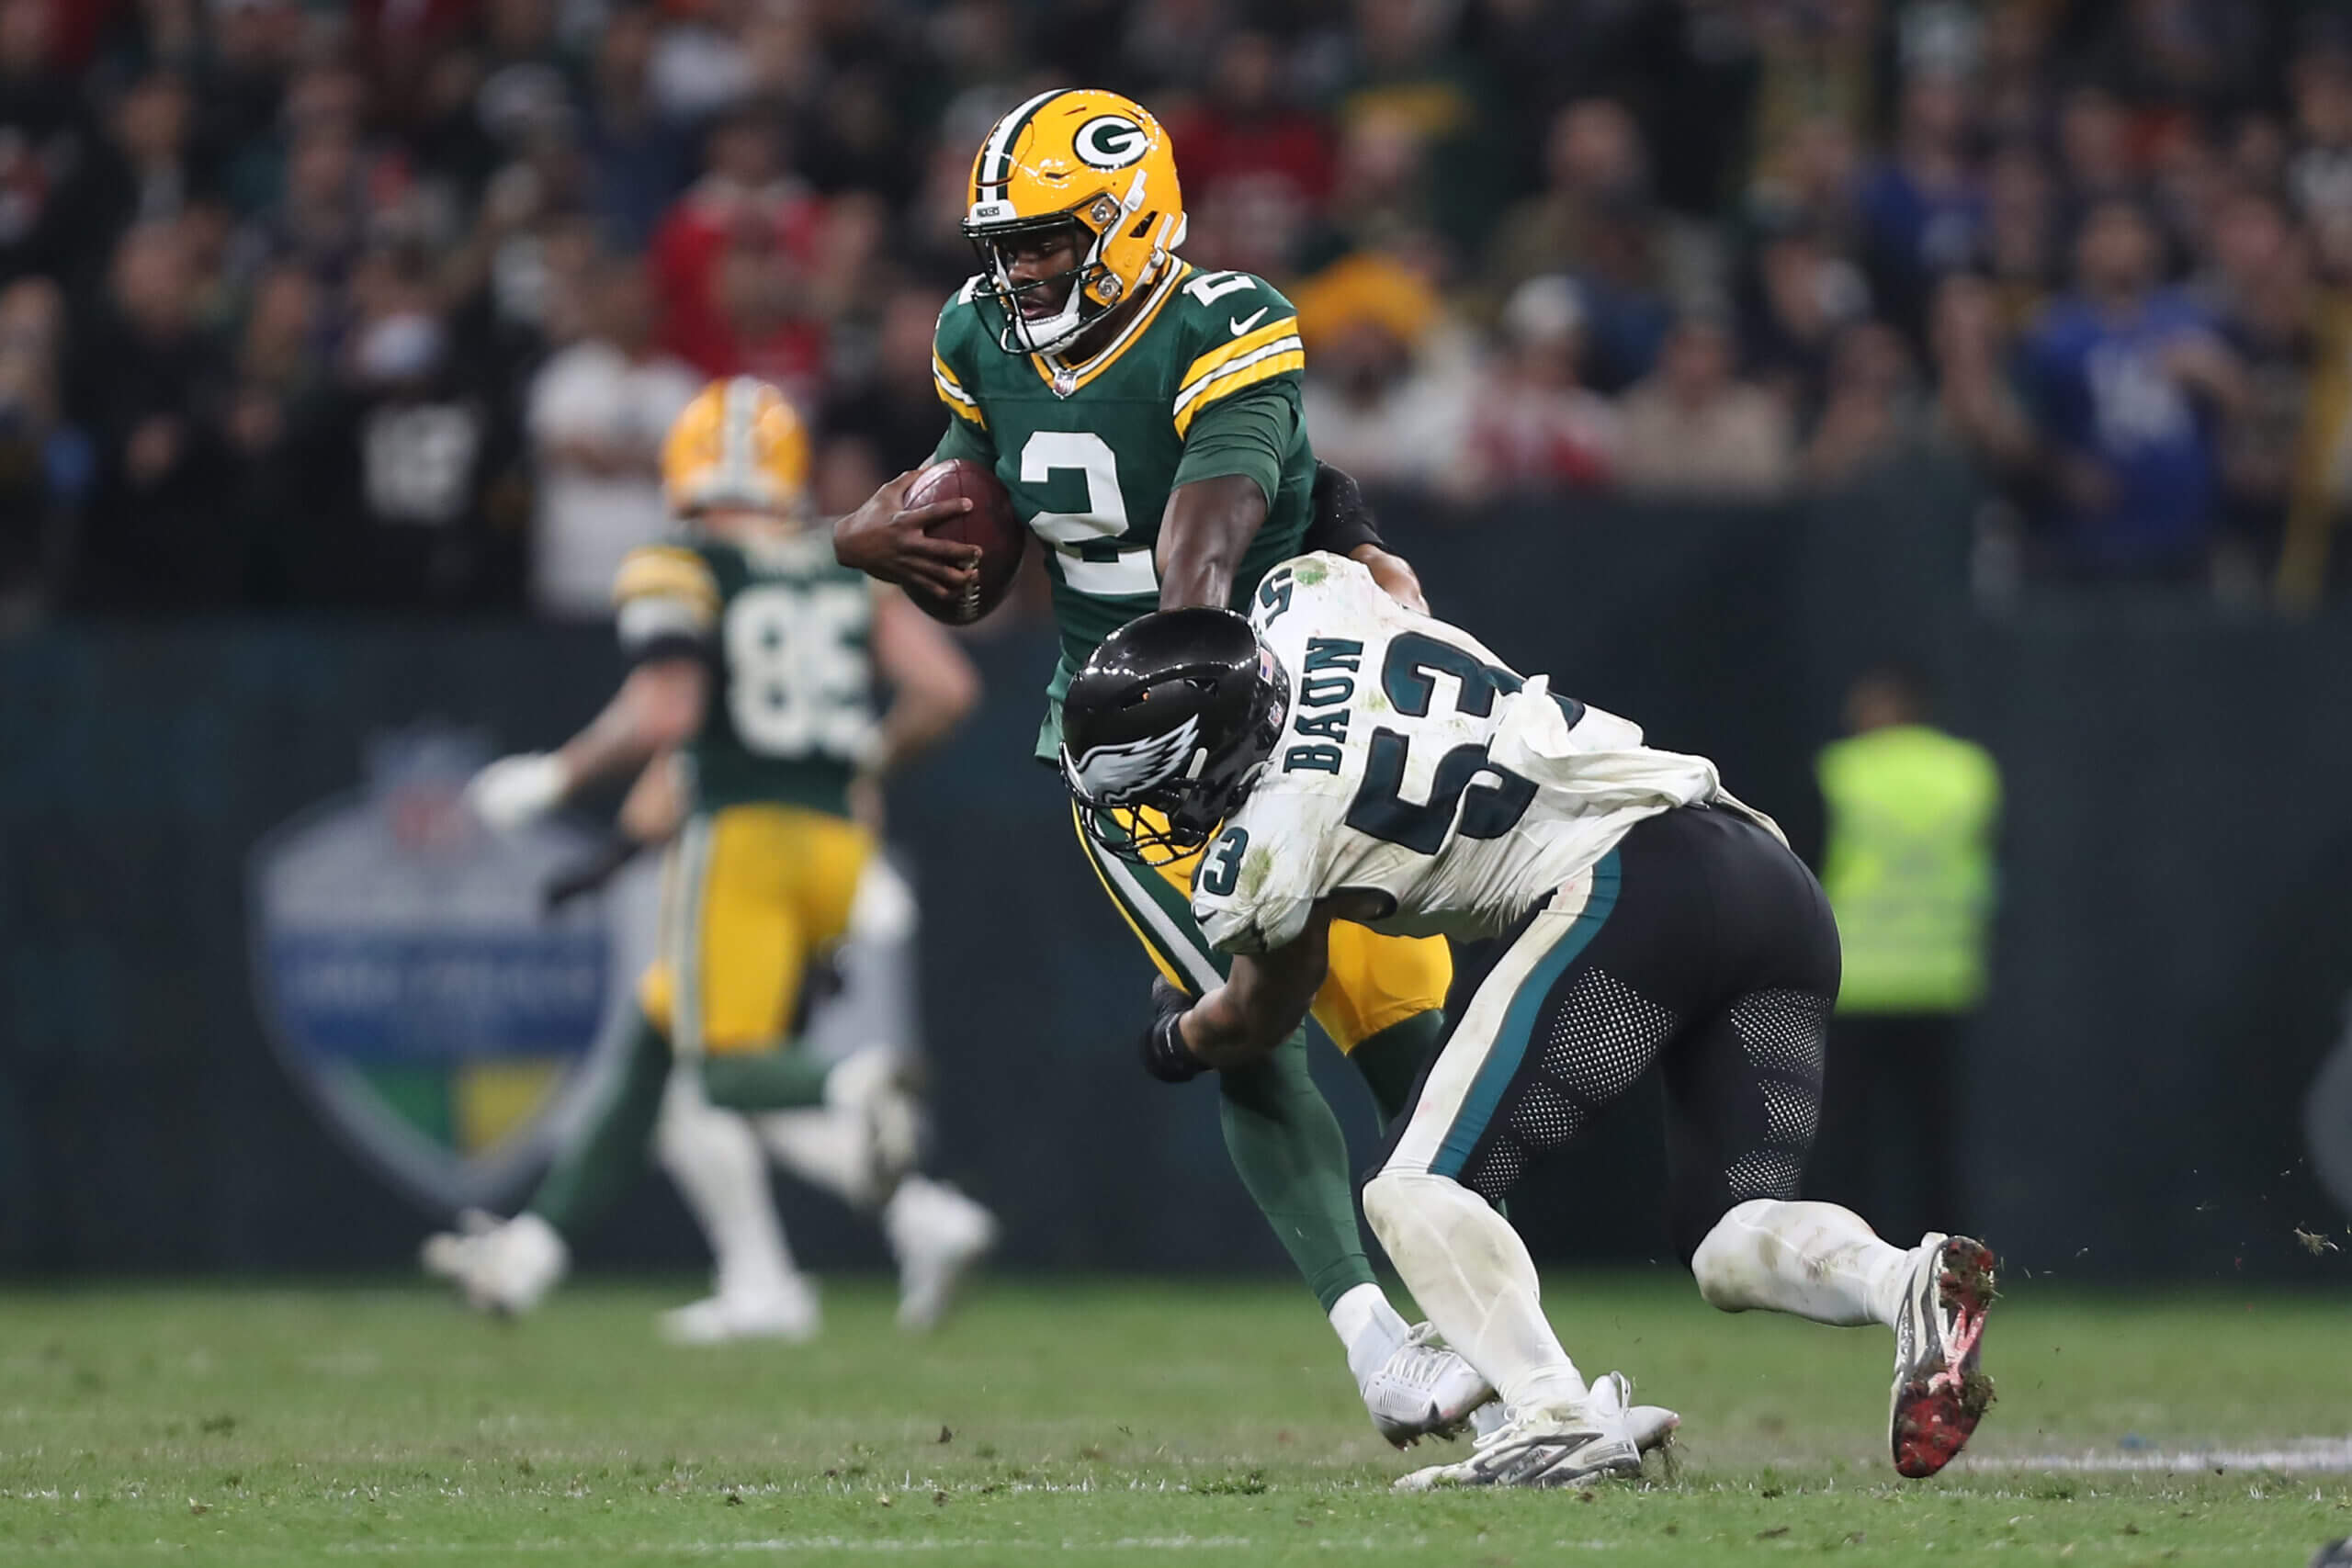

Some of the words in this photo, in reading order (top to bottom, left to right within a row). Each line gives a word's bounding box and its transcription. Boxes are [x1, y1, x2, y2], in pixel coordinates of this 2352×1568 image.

[1073, 115, 1148, 168] G
[1020, 430, 1159, 595] 2
[723, 582, 875, 761] 85
[1248, 566, 1294, 630] 5
[1283, 637, 1363, 775] BAUN
[1344, 631, 1587, 856] 53
